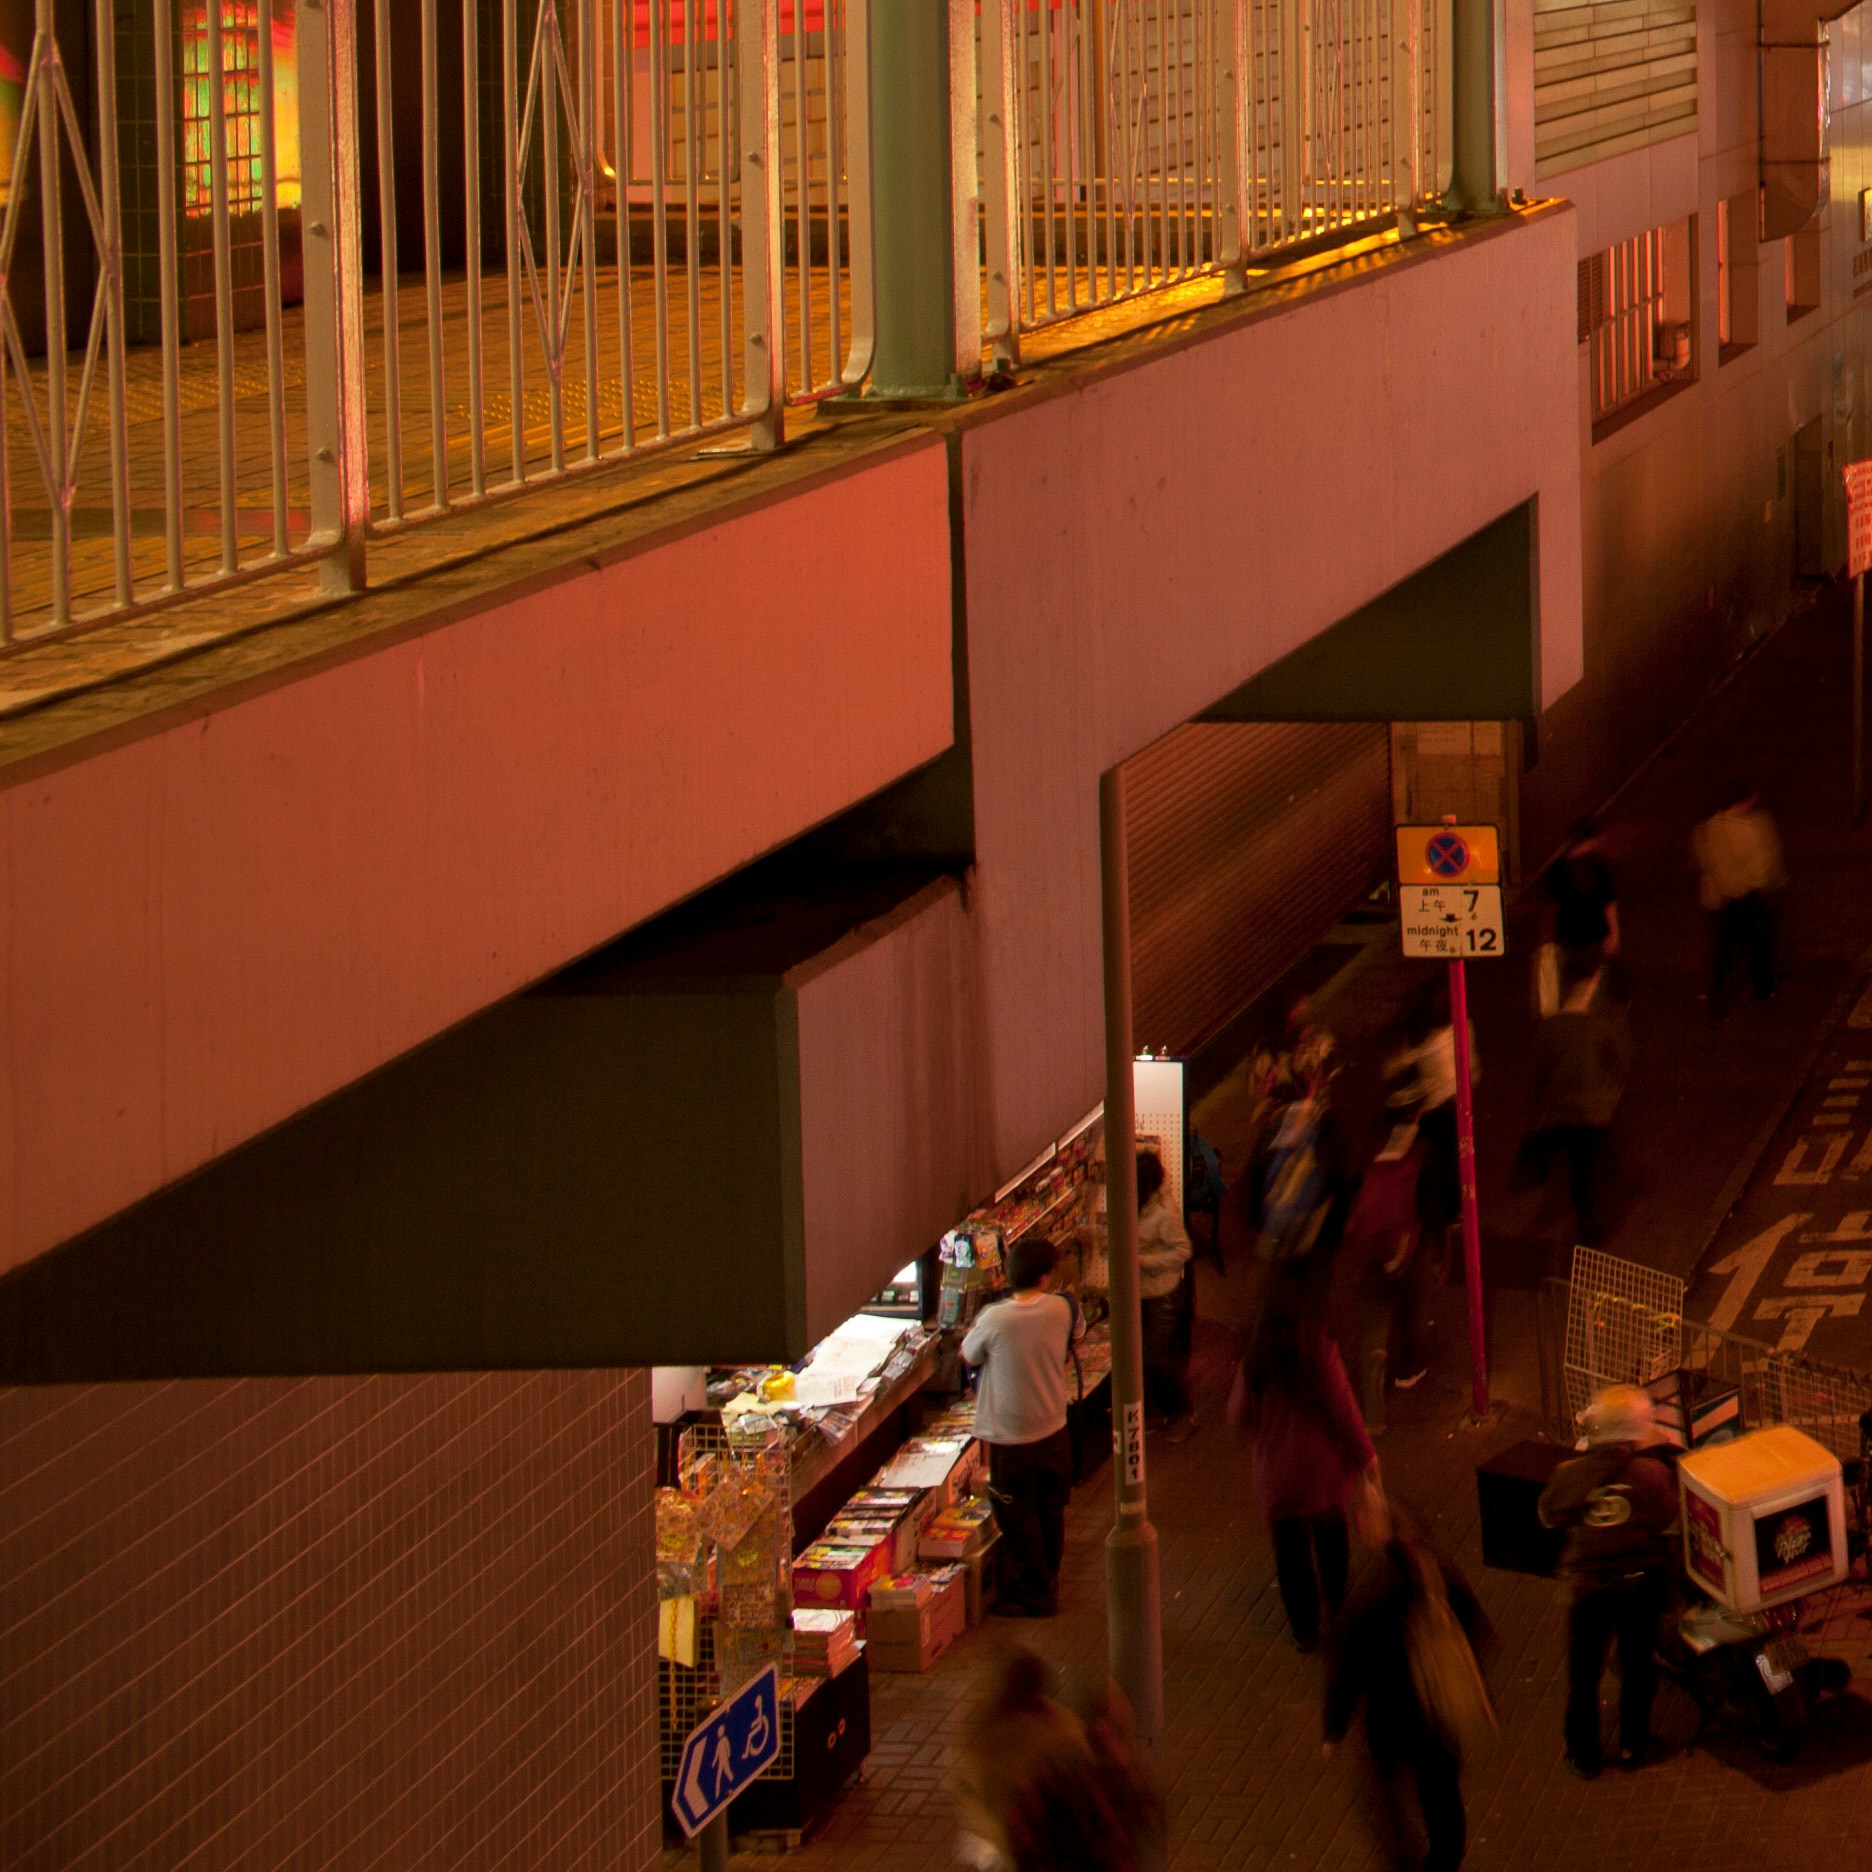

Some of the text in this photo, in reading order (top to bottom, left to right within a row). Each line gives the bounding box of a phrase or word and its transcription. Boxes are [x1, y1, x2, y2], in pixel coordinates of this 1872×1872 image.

[1418, 899, 1447, 913] 上午
[1422, 887, 1480, 913] am 7
[1406, 924, 1497, 952] midnight 12
[1419, 939, 1448, 953] 午夜
